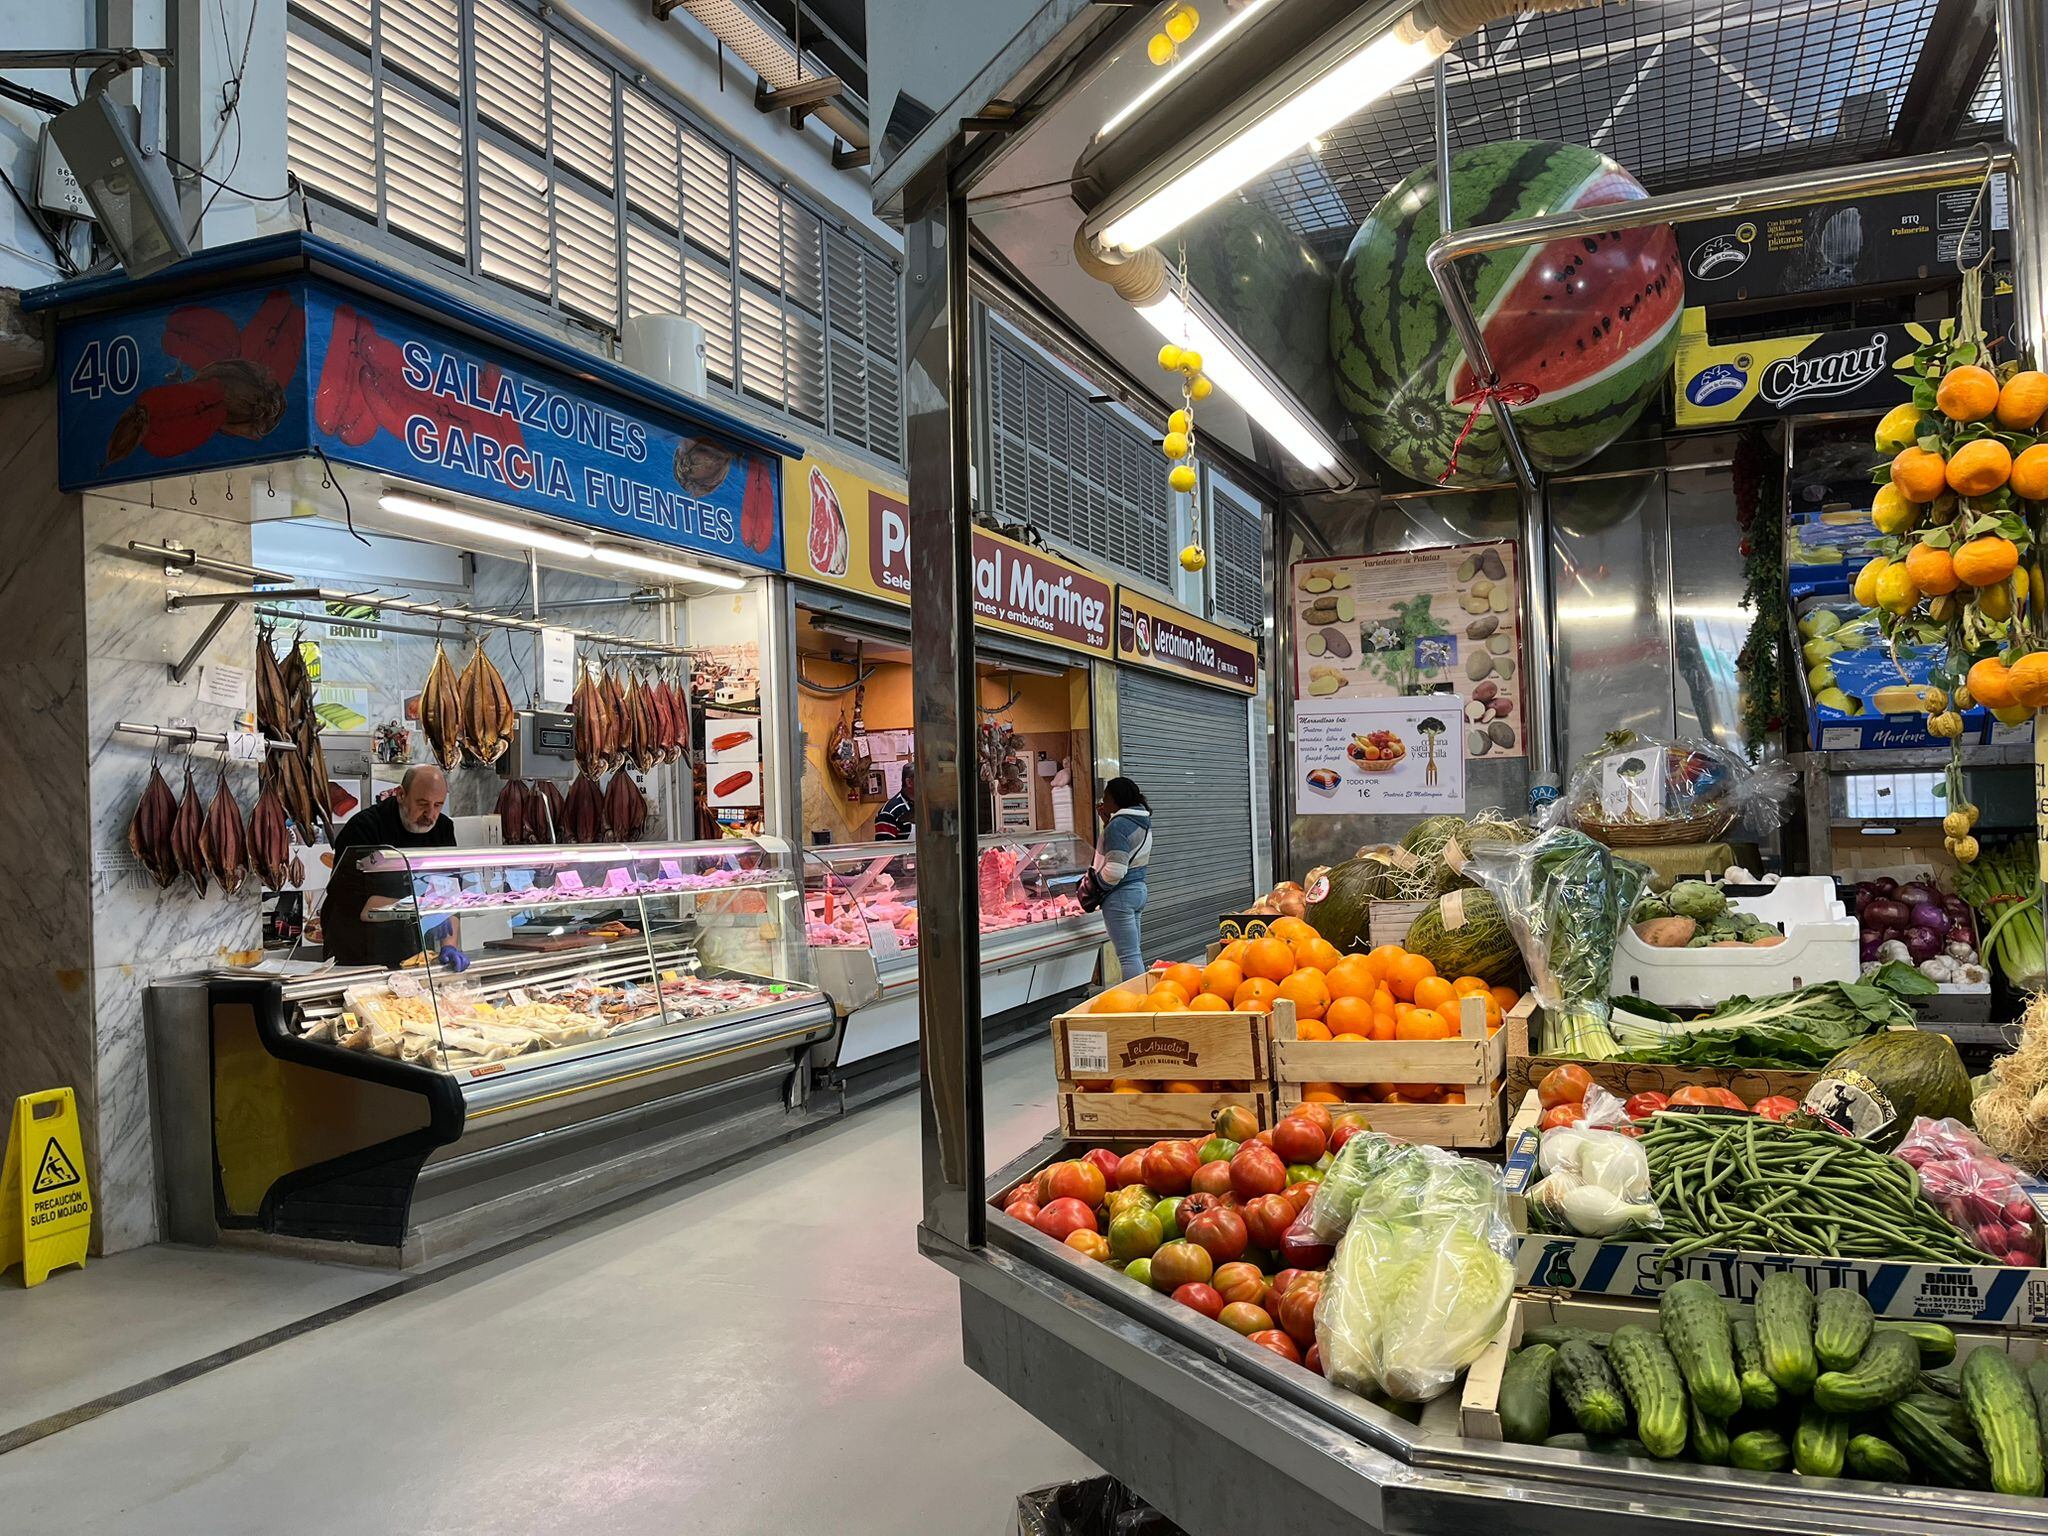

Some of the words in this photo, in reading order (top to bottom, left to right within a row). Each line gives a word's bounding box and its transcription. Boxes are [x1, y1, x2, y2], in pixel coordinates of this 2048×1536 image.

[1891, 225, 1930, 236] Palmerita
[1901, 215, 1920, 225] BTQ
[71, 335, 140, 400] 40
[1759, 334, 1888, 403] Cuqui
[402, 341, 647, 463] SALAZONES
[405, 415, 576, 503] GARCIA
[584, 466, 735, 544] FUENTES
[1413, 554, 1441, 563] Patatas
[1009, 559, 1105, 633] Martínez
[999, 608, 1006, 619] y
[1007, 609, 1054, 632] embutidos
[1086, 633, 1104, 646] 38-39
[1154, 623, 1195, 661] Jerónimo
[1196, 637, 1215, 668] Roca
[234, 733, 257, 760] 12
[1873, 728, 1926, 747] Marlene
[1358, 788, 1371, 798] 1€
[1134, 1043, 1142, 1054] el
[1145, 1041, 1183, 1053] Abuelo
[34, 1191, 82, 1212] PRECAUCIÓN
[31, 1211, 56, 1227] SUELO
[57, 1202, 88, 1219] MOJADO
[1925, 1273, 1973, 1286] SANUI
[1921, 1284, 1978, 1297] FRUITS
